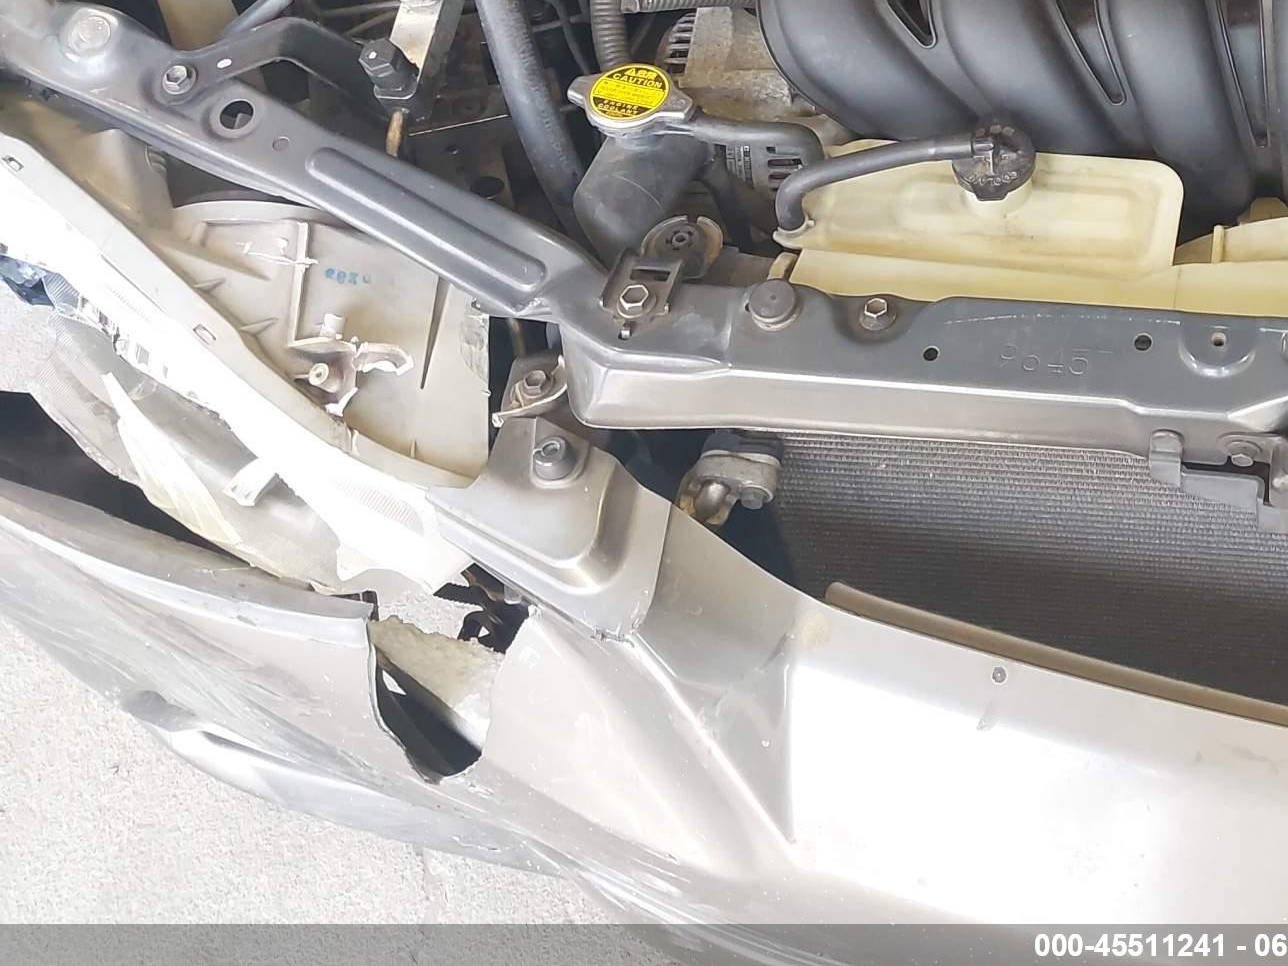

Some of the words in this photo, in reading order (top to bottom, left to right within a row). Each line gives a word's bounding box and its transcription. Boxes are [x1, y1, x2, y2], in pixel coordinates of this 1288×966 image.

[612, 73, 662, 88] CAUTION
[598, 103, 639, 115] COOLANT
[603, 99, 639, 111] ENGINE
